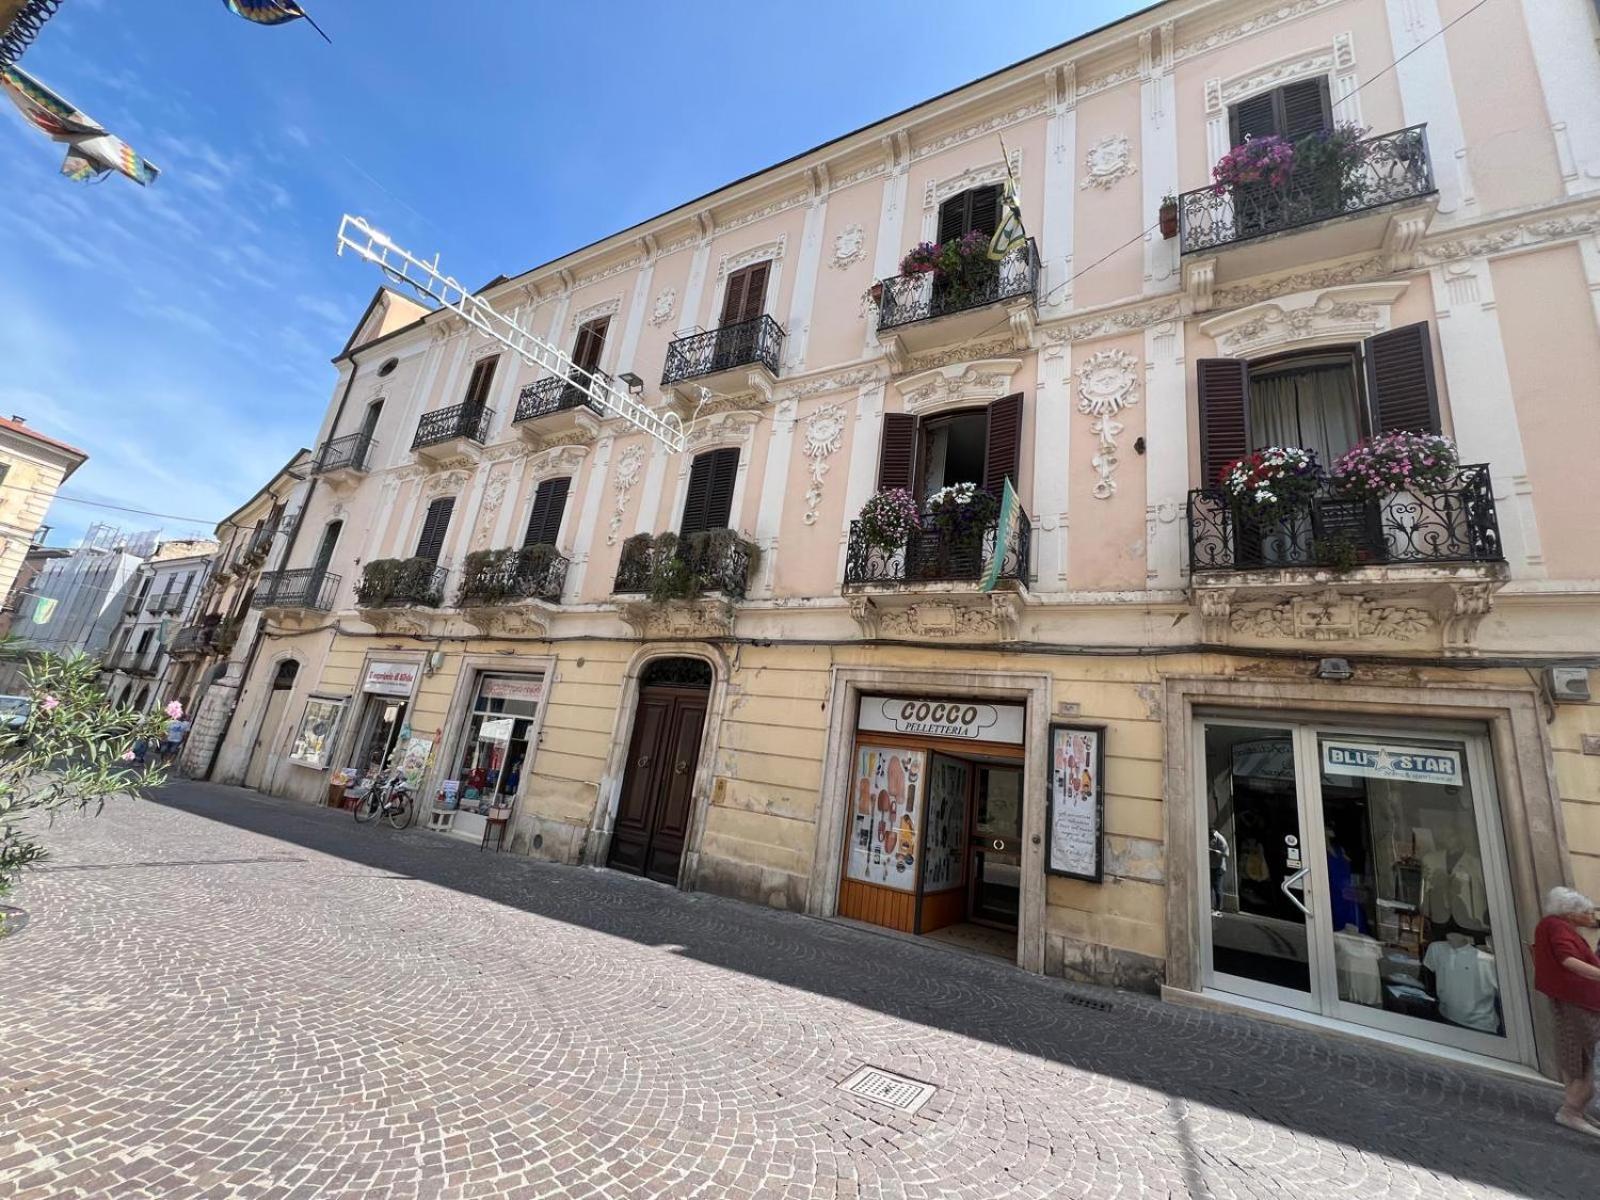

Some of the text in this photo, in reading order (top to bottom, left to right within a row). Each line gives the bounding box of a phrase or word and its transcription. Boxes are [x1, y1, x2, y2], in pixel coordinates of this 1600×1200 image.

[900, 701, 978, 726] COCCO
[905, 722, 968, 736] PELLETTERIA
[1331, 749, 1368, 765] BLU
[1400, 755, 1454, 774] STAR
